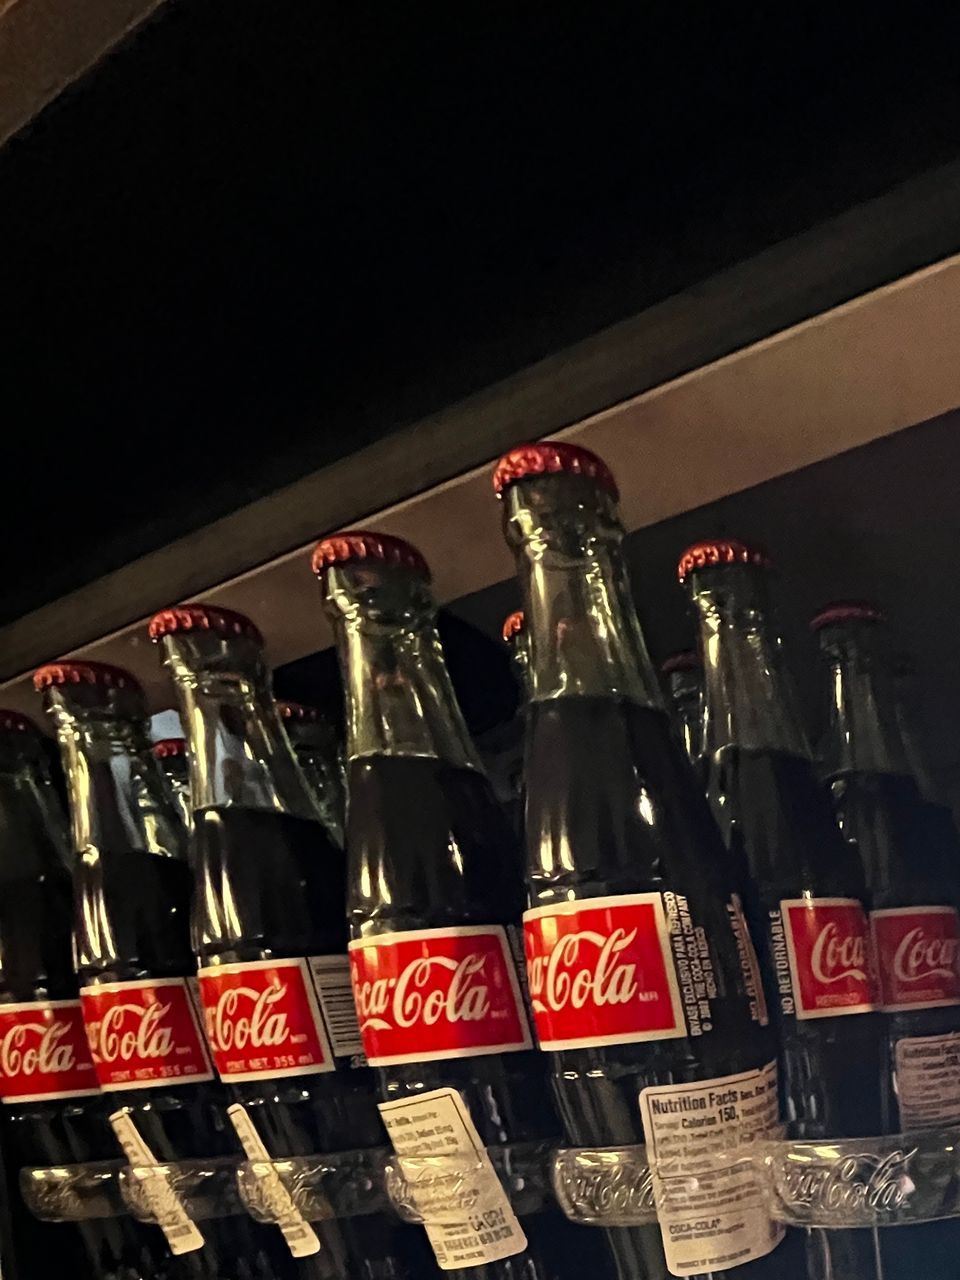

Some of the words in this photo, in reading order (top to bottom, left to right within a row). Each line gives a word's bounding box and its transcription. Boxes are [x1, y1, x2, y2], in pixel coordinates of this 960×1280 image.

[768, 909, 790, 996] RETORNABLE
[779, 997, 796, 1016] NO
[651, 1095, 707, 1116] Nutrition
[708, 1089, 739, 1110] Facts
[681, 1115, 718, 1130] Calories
[718, 1105, 741, 1125] 150,
